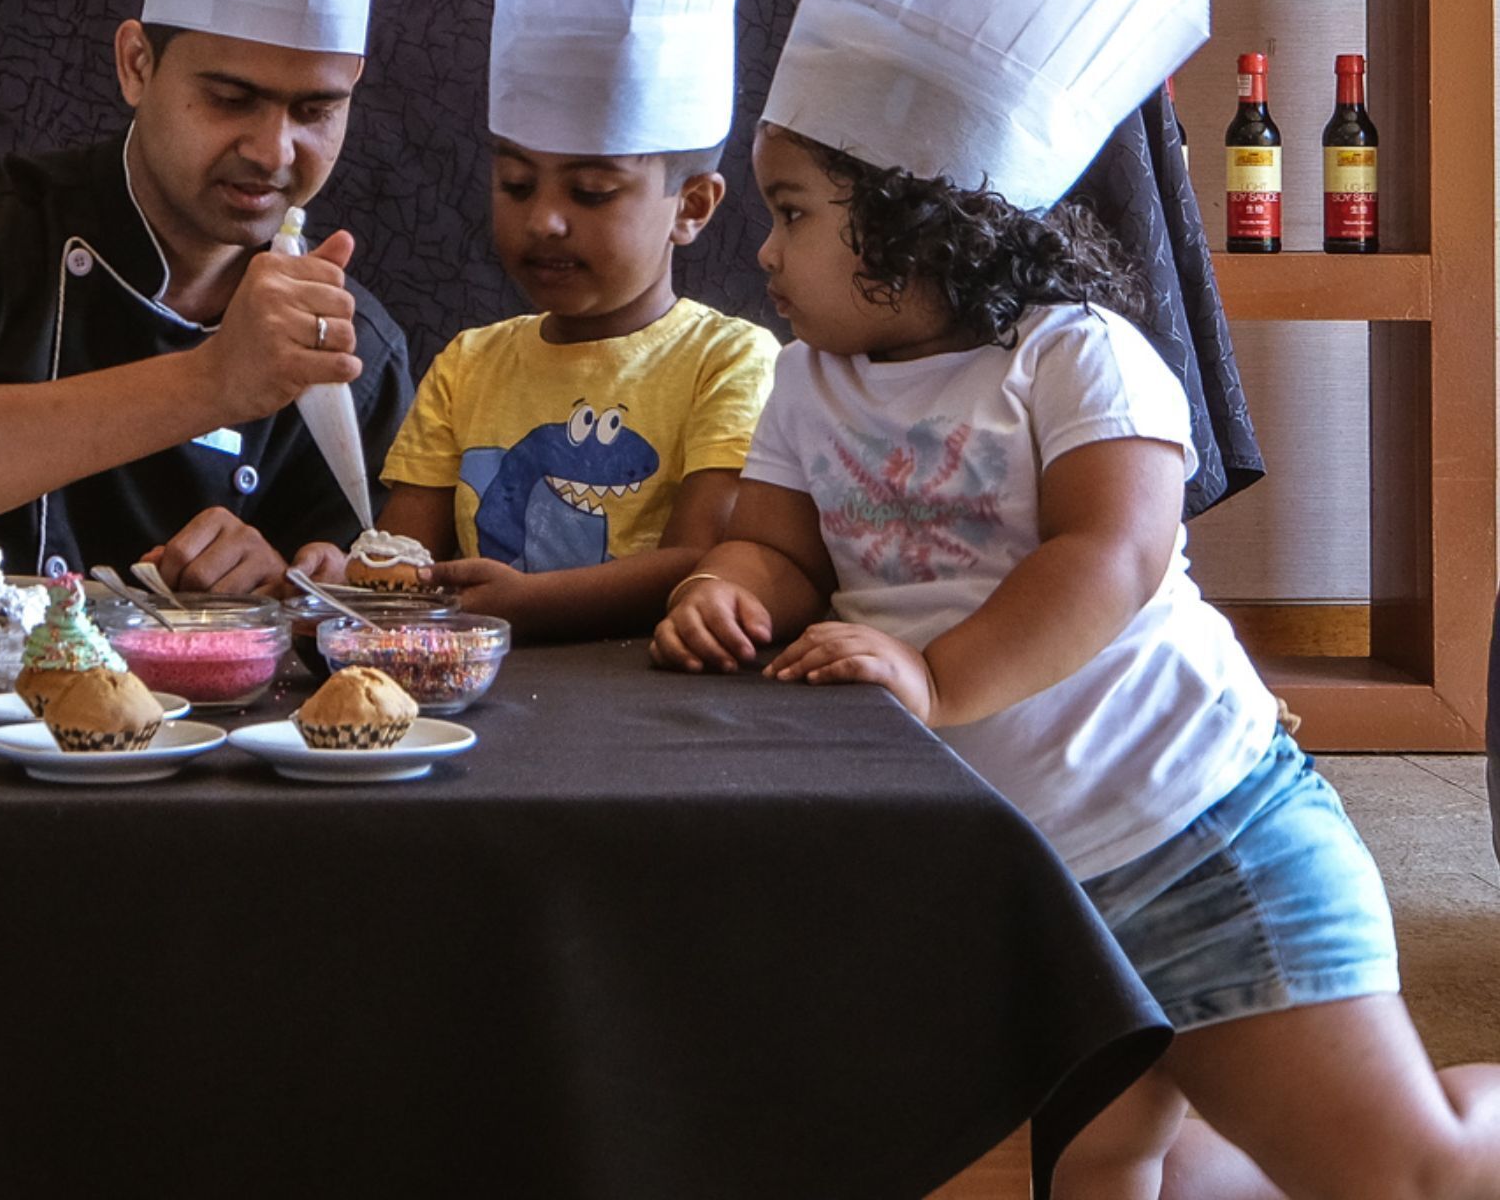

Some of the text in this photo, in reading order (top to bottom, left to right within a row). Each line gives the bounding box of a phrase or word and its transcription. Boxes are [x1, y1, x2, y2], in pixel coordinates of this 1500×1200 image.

[1241, 183, 1268, 191] LIGHT
[1344, 183, 1371, 191] LIGHT
[1231, 192, 1279, 202] SOY SAUCE
[1332, 192, 1351, 202] SOY
